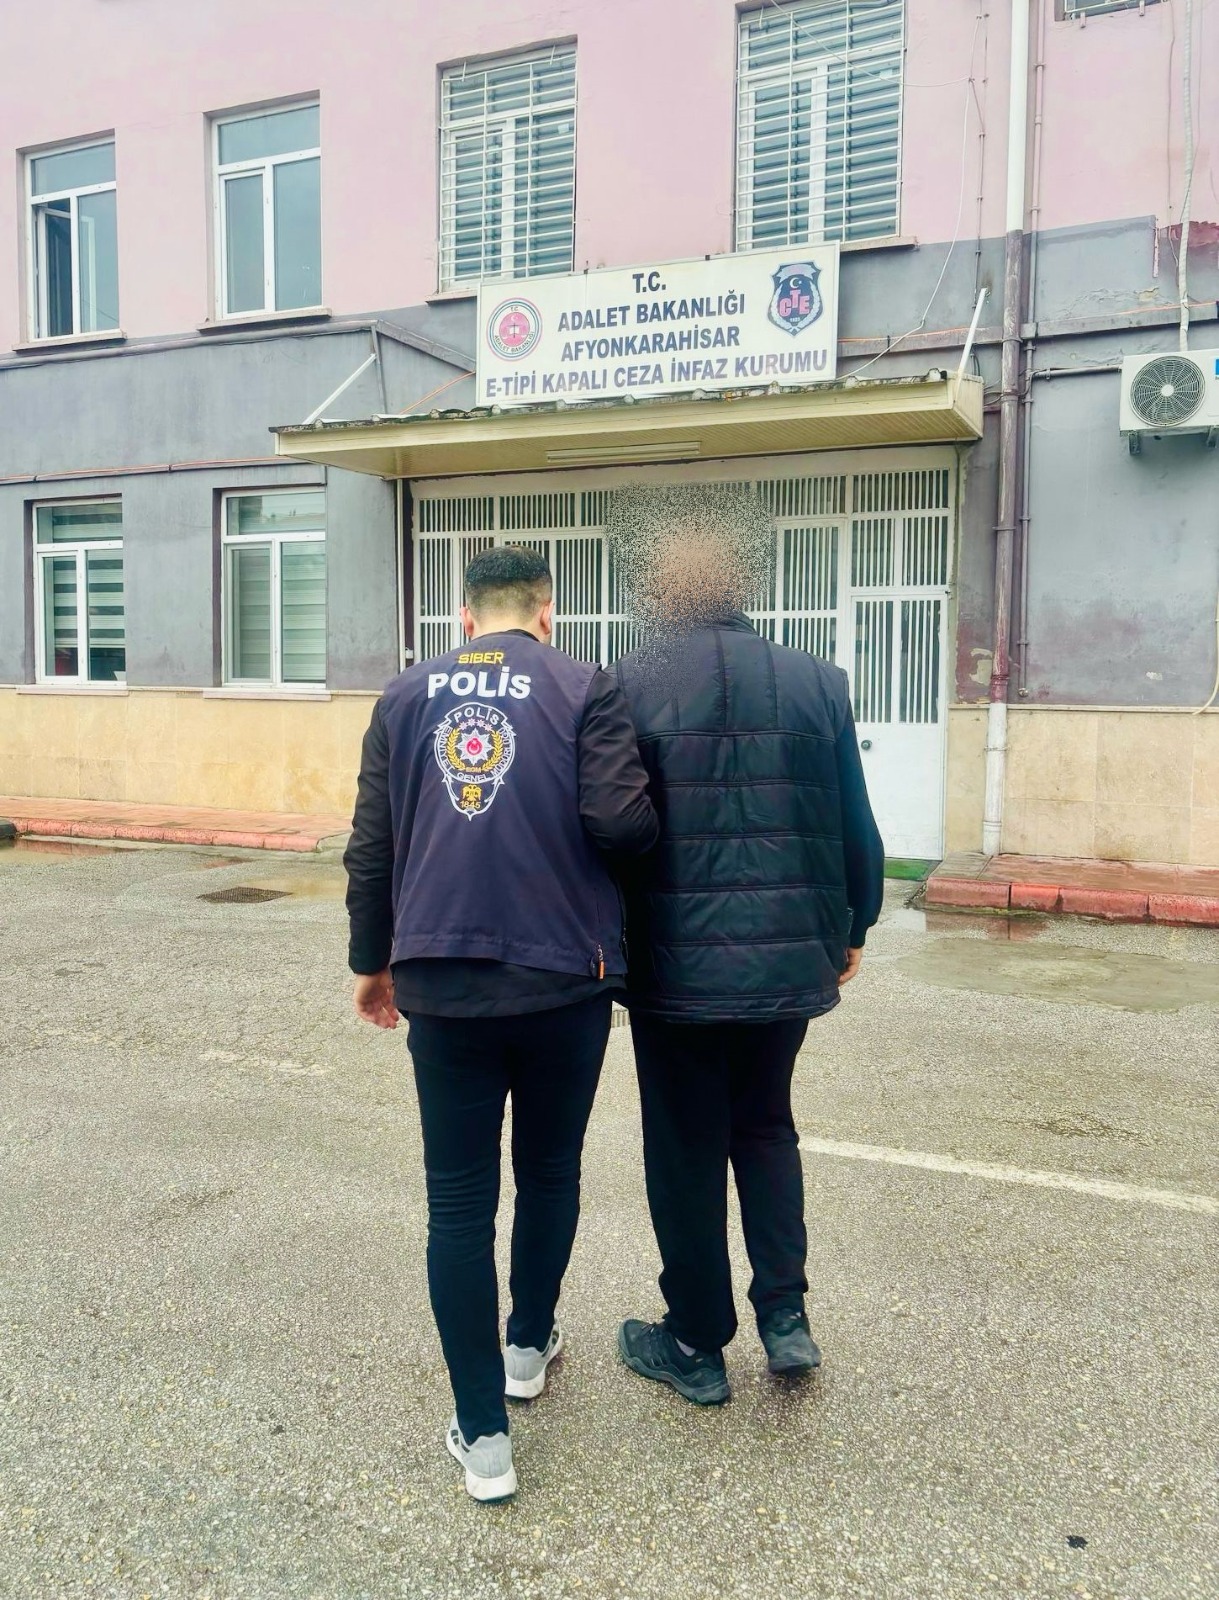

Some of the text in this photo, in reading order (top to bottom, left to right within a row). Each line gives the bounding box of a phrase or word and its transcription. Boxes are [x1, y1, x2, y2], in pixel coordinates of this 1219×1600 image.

[632, 271, 666, 293] T.C.
[558, 289, 745, 332] ADALET BAKANLIĞI
[779, 290, 810, 317] CTE
[561, 325, 740, 362] AFYONKARAHİSAR
[486, 350, 827, 397] E-TİPİ KAPALI CEZA İNFAZ KURUMU
[428, 666, 531, 699] POLİS
[454, 707, 499, 725] POLİS
[457, 772, 488, 782] GENEL
[460, 800, 481, 809] 1845
